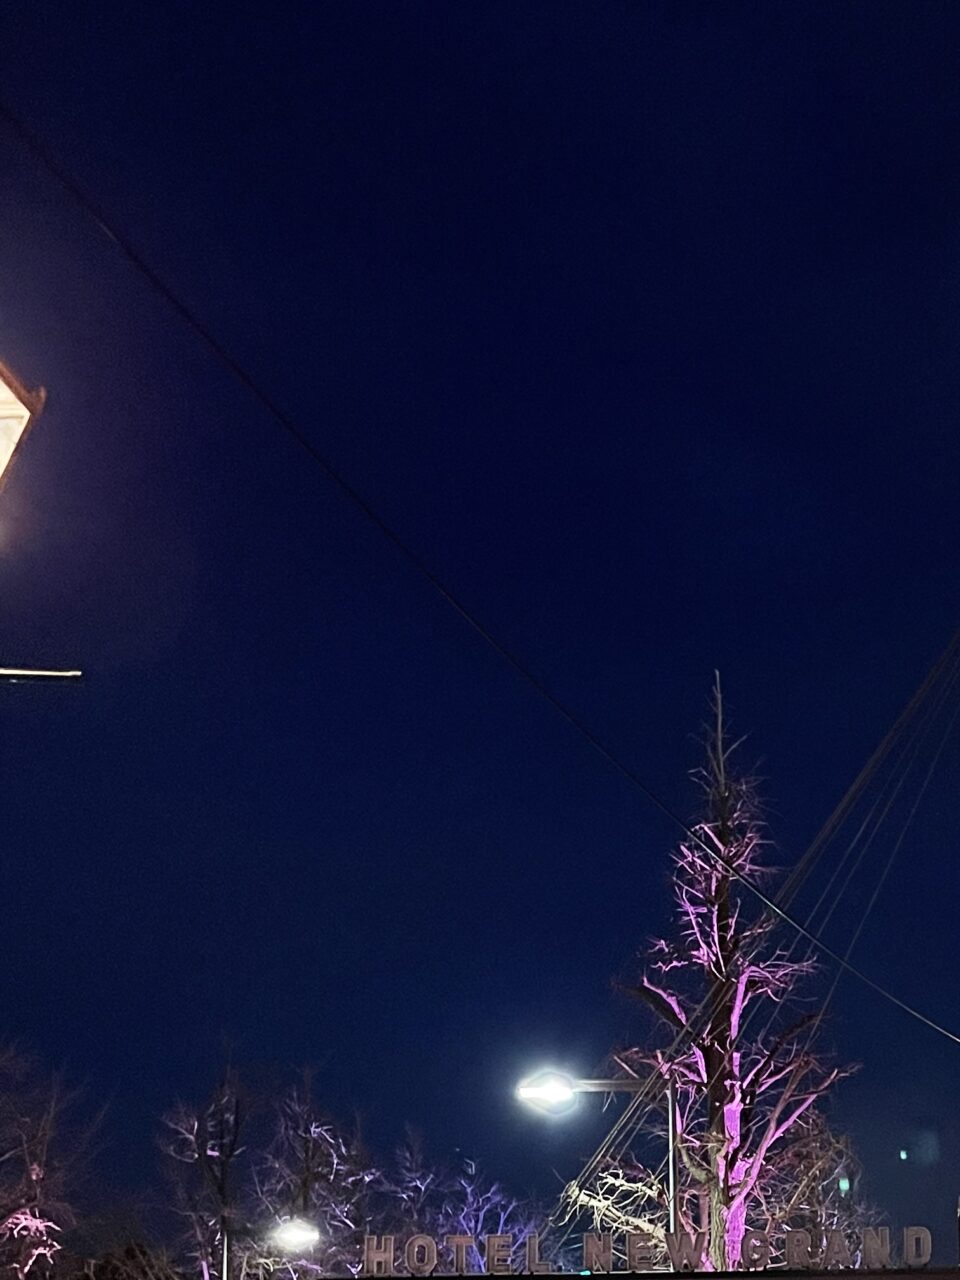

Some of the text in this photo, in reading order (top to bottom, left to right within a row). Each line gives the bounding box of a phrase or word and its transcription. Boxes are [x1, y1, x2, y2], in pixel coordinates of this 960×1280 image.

[363, 1226, 932, 1275] HOTEL NEW GRAND
